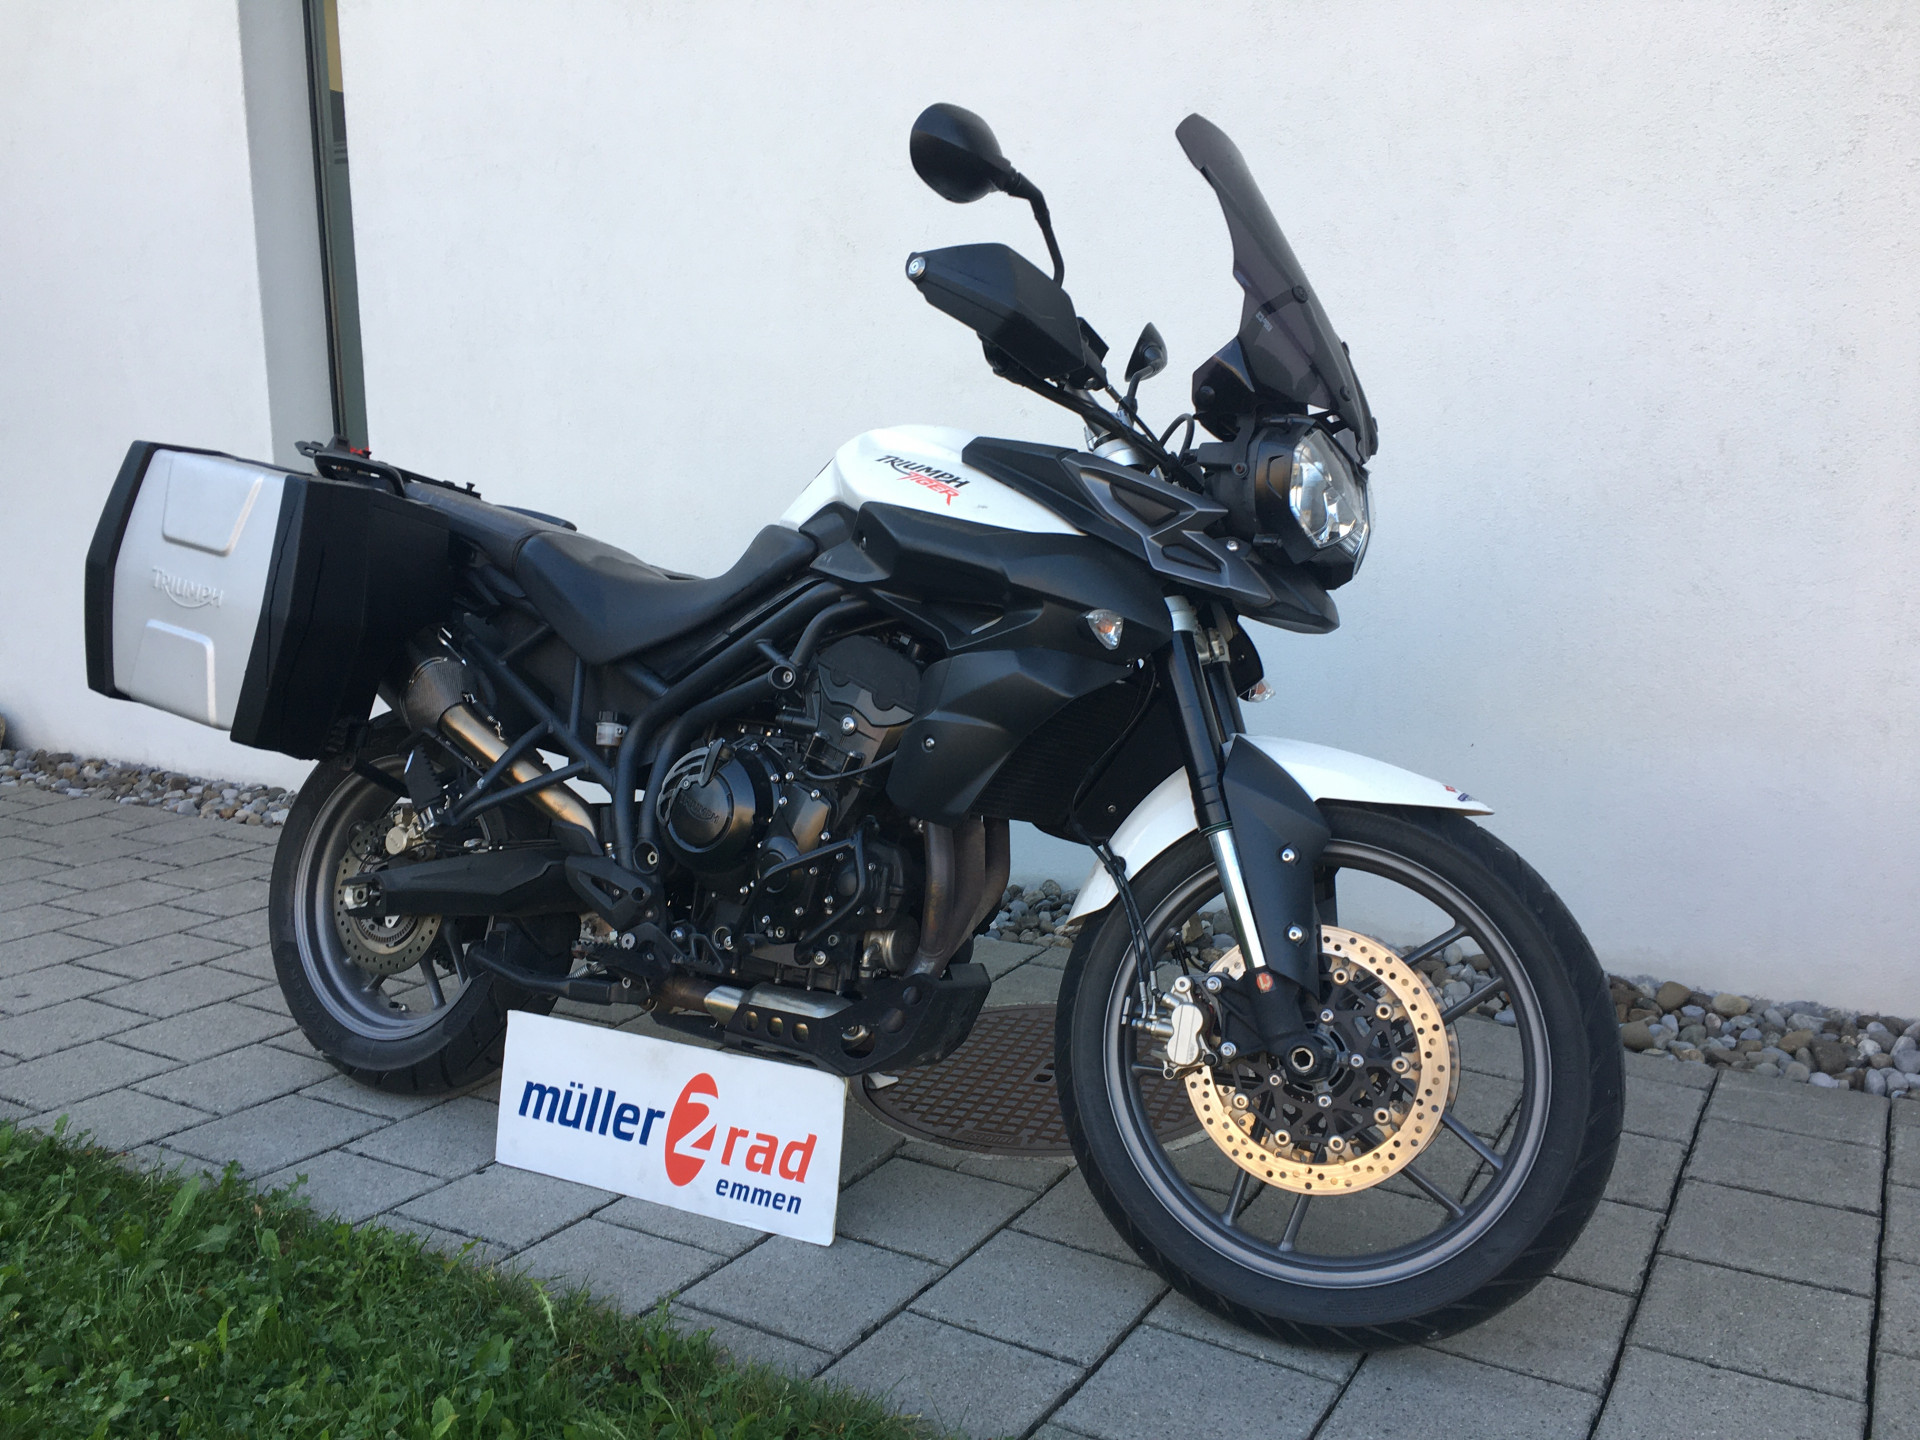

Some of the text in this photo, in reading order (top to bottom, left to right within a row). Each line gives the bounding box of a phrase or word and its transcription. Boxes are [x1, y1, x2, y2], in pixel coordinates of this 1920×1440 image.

[875, 455, 970, 489] TRIUMPH
[896, 471, 960, 506] TIGER
[152, 565, 224, 609] TRIUMPH
[518, 1080, 666, 1146] müller
[720, 1126, 818, 1184] rad
[715, 1178, 802, 1215] emmen
